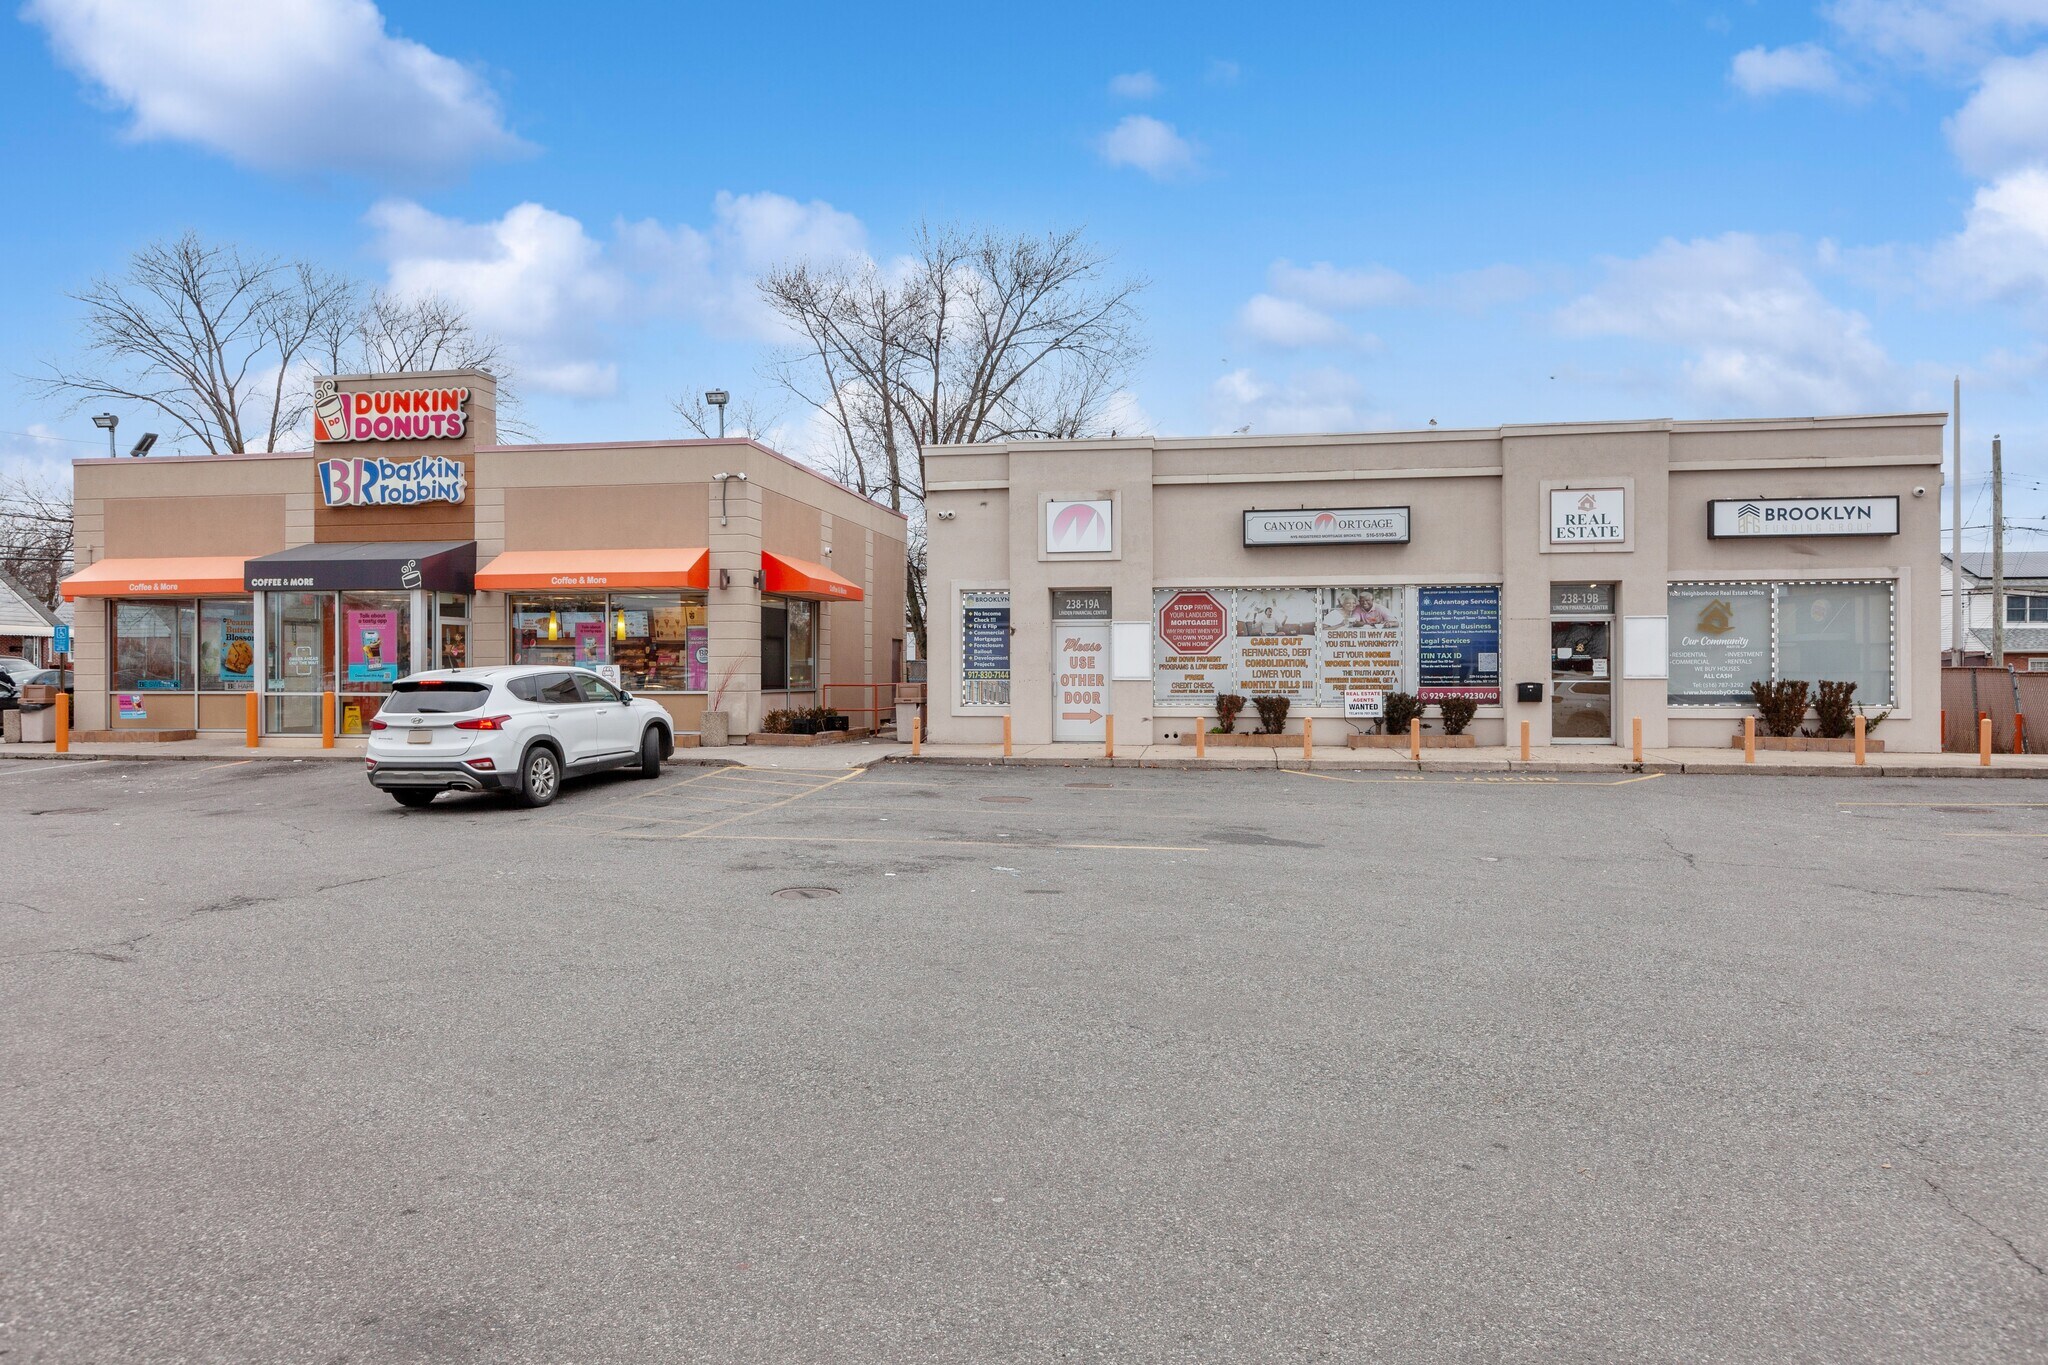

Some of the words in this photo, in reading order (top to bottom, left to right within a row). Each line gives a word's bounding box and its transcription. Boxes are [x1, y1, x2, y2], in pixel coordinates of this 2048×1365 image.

[355, 389, 466, 415] DUNKIN'
[329, 417, 340, 427] DD
[355, 414, 461, 439] DONUTS
[379, 456, 459, 482] baskin
[380, 480, 459, 504] robbins
[1565, 513, 1611, 526] REAL
[1765, 506, 1872, 522] BROOKLYN
[1264, 521, 1312, 531] CANYON
[1556, 526, 1620, 538] ESTATE
[1765, 524, 1822, 533] FUNDING
[1829, 523, 1872, 532] GROUP
[251, 578, 282, 586] COFFEE
[290, 578, 314, 586] MORE
[551, 576, 577, 584] Coffee
[586, 576, 607, 584] More
[1066, 599, 1100, 609] 238-19A
[1561, 594, 1599, 603] 238-19B
[1063, 638, 1102, 652] Please
[1250, 638, 1279, 646] CASH
[1682, 636, 1699, 646] Our
[1700, 636, 1748, 648] Community
[1242, 648, 1290, 657] REFINANCES,
[1292, 648, 1312, 656] DEBT
[1070, 656, 1096, 669] USE
[1245, 659, 1308, 668] CONSOLIDATION,
[1060, 674, 1104, 686] OTHER
[1252, 670, 1279, 678] LOWER
[1280, 670, 1301, 678] YOUR
[1064, 691, 1101, 704] DOOR
